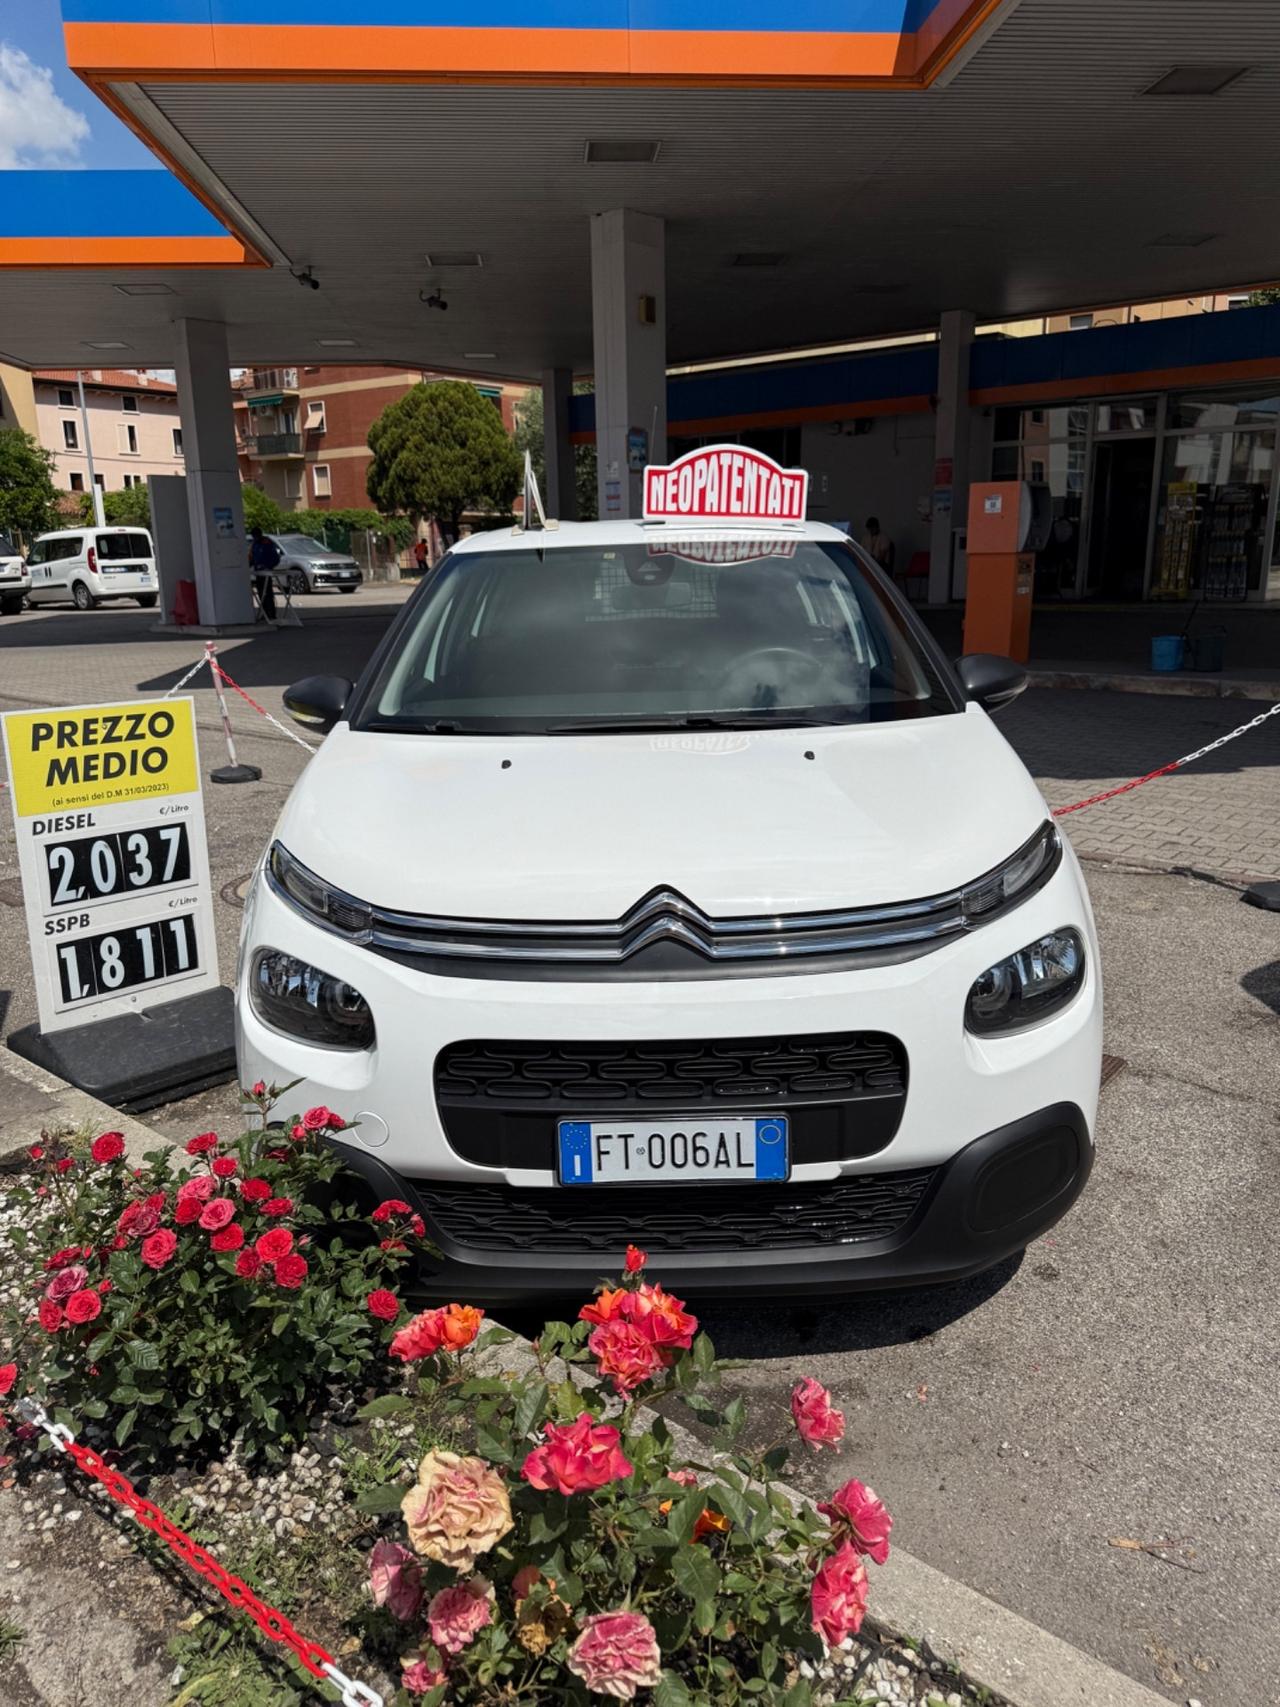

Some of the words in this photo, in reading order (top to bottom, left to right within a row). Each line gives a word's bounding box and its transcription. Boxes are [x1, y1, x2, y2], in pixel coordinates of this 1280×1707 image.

[650, 452, 801, 515] NEOPATENTATI
[31, 711, 175, 752] PREZZO
[45, 746, 168, 788] MEDIO
[52, 797, 64, 808] (ai
[65, 794, 89, 804] sensi
[106, 789, 123, 799] D.M
[124, 783, 169, 797] 31/03/2023)
[32, 813, 96, 836] DIESEL
[48, 827, 181, 904] 2,037
[43, 913, 91, 936] SSPB
[59, 918, 190, 1001] 1,811
